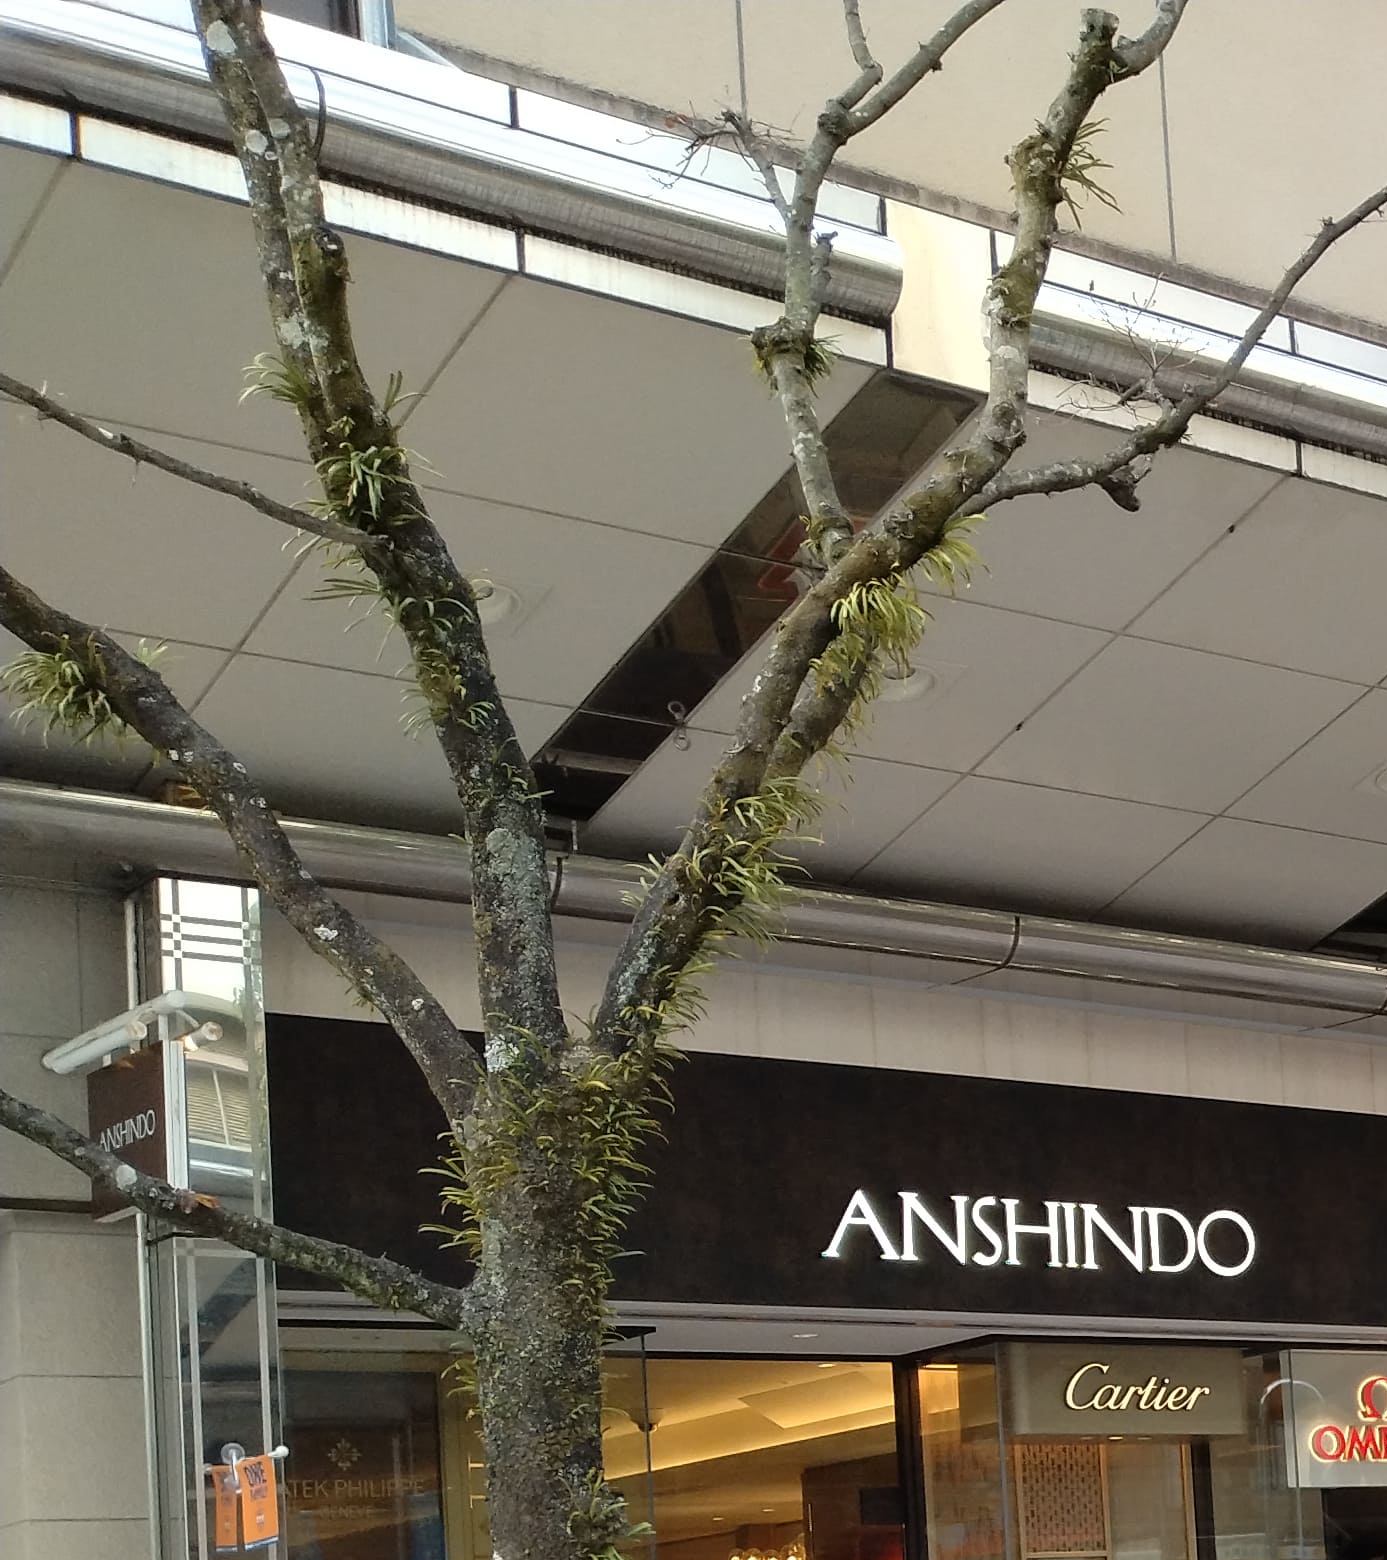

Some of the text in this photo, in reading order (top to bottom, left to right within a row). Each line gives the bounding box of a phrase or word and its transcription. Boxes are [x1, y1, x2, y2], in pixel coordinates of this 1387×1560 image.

[99, 1109, 156, 1153] ANSHINDO
[821, 1187, 1256, 1278] ANSHINDO
[1064, 1363, 1210, 1412] Cartier
